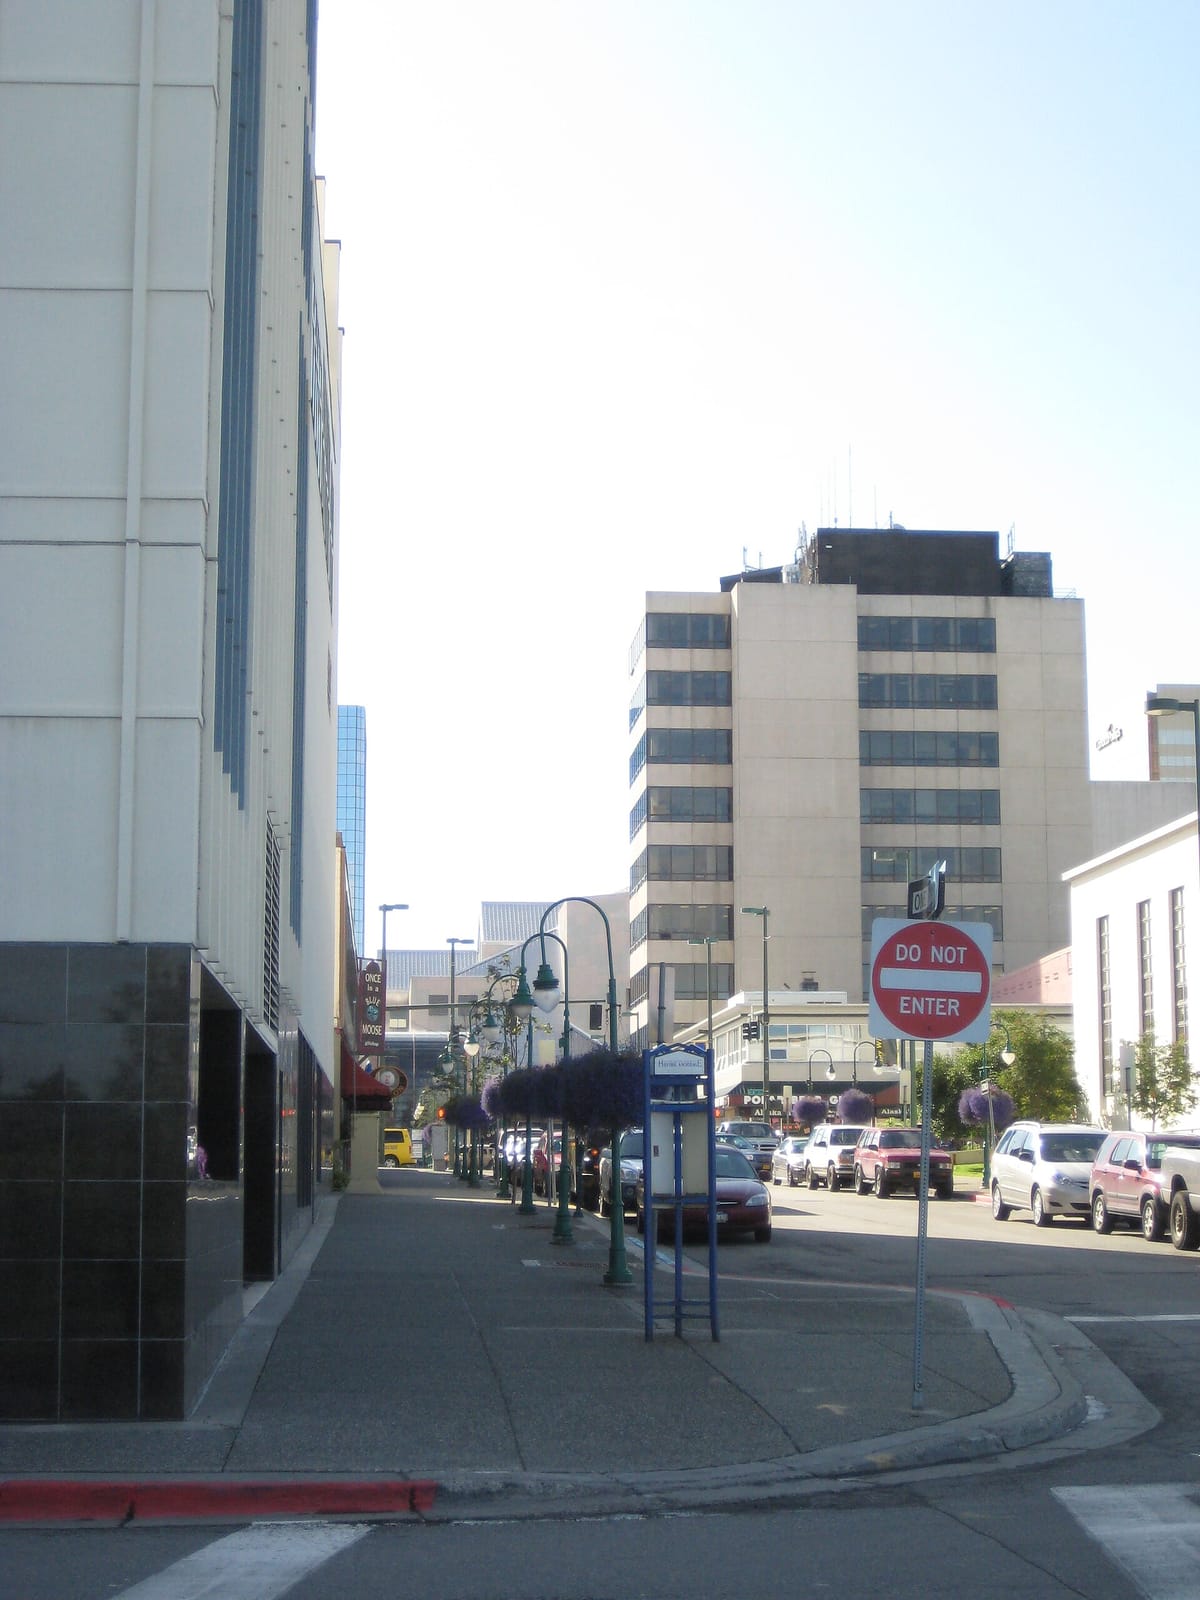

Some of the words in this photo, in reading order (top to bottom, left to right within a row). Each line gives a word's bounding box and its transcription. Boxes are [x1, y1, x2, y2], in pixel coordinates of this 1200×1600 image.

[895, 943, 921, 962] DO
[931, 945, 968, 964] NOT
[365, 973, 381, 983] ONCE
[365, 996, 380, 1007] BLUE
[899, 996, 960, 1017] ENTER
[362, 1024, 382, 1036] MOOSE
